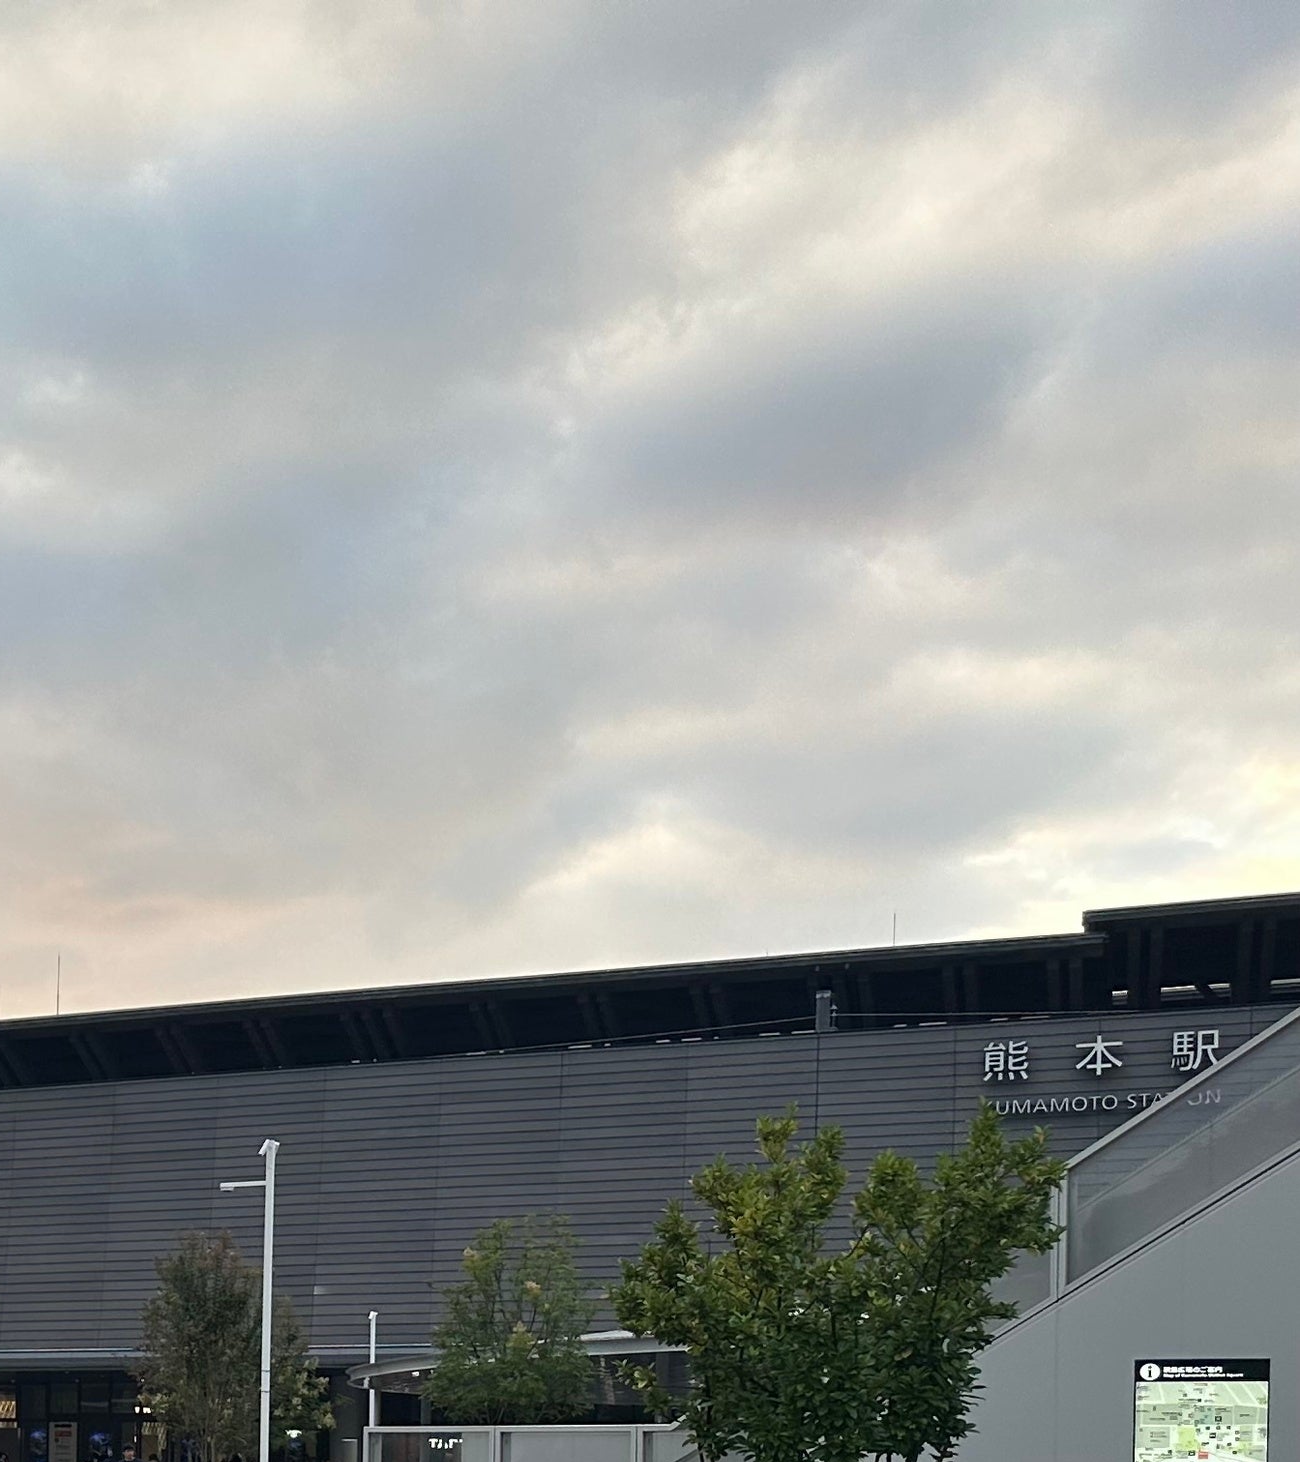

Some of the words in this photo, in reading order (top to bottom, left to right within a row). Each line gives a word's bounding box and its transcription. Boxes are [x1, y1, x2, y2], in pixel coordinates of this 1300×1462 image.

[982, 1028, 1220, 1082] 熊本駅
[985, 1094, 1118, 1116] UMAMOTO
